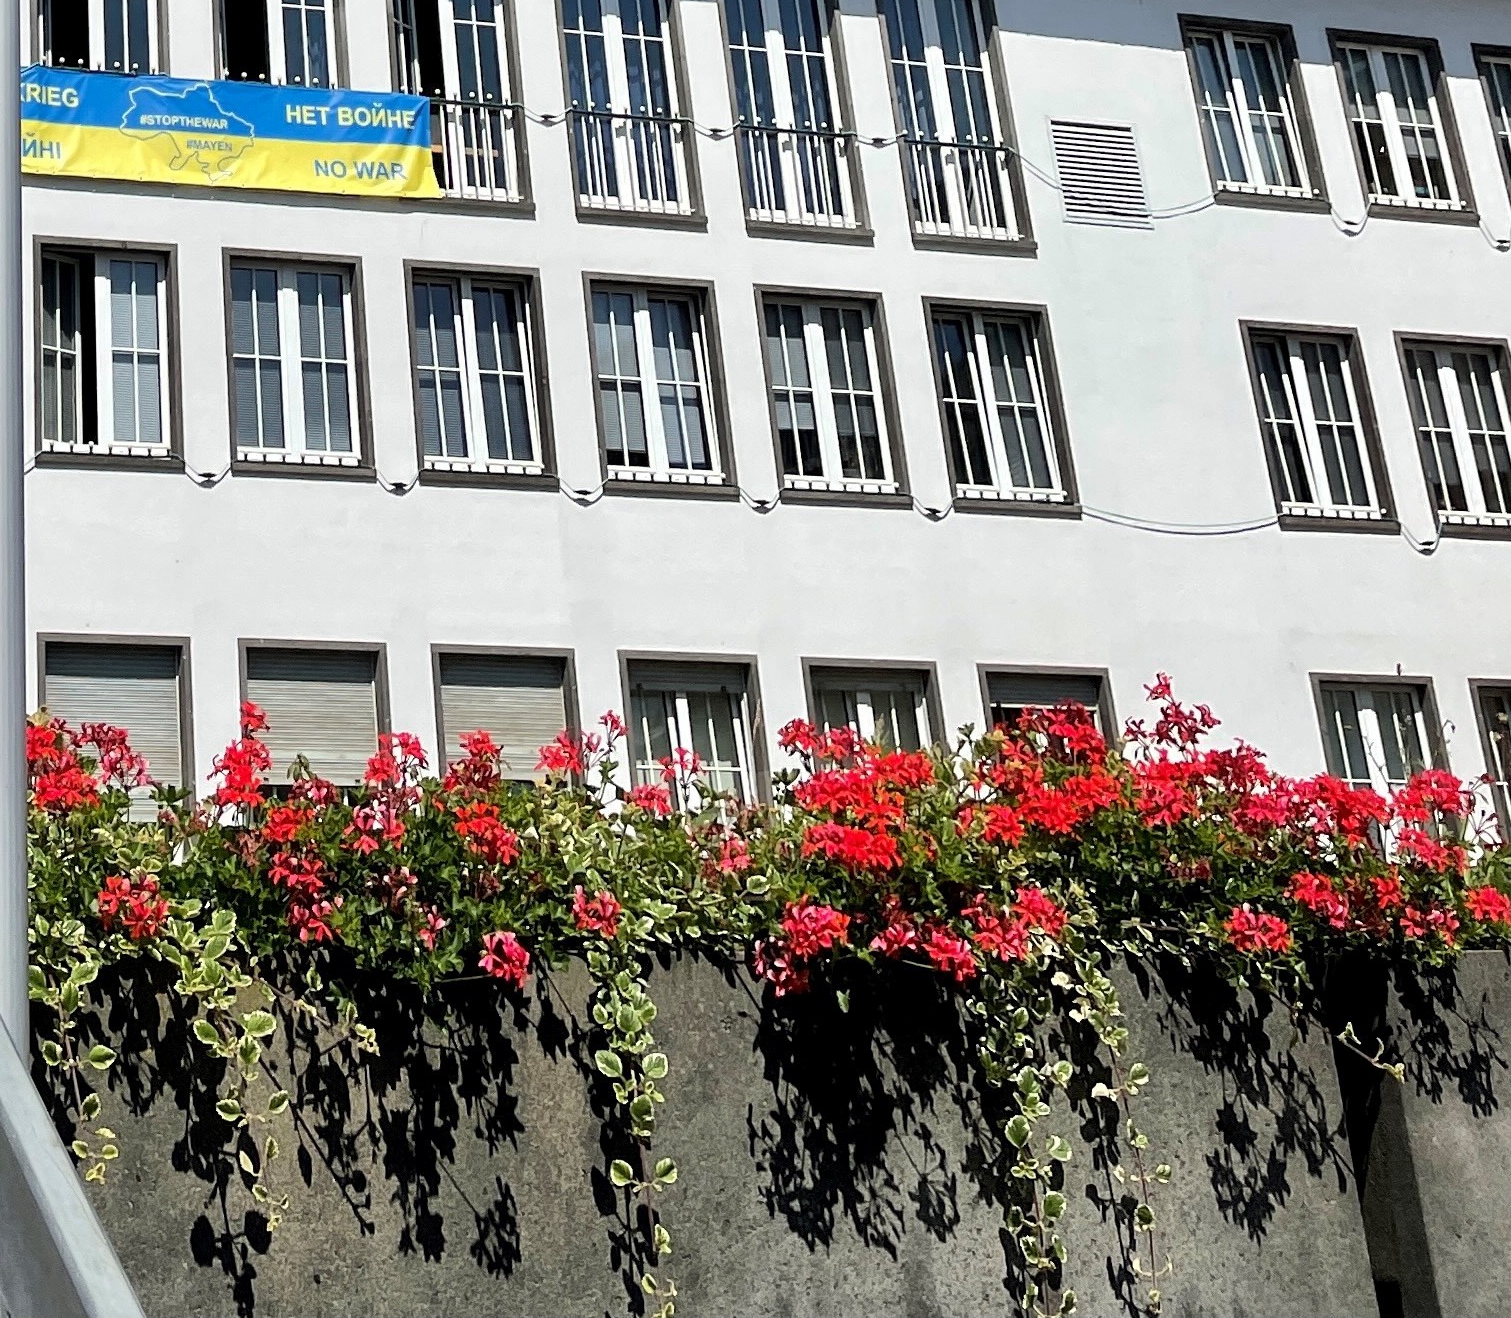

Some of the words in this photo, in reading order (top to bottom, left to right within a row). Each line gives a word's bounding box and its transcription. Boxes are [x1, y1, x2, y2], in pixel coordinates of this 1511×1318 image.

[139, 114, 228, 130] #STOPTHEWAR
[285, 104, 330, 126] НЕТ
[338, 102, 416, 130] ВОЙНЕ
[22, 132, 61, 159] ЙНІ
[186, 138, 233, 152] #MAYEN
[314, 159, 347, 178] NO
[353, 160, 408, 181] WAR
